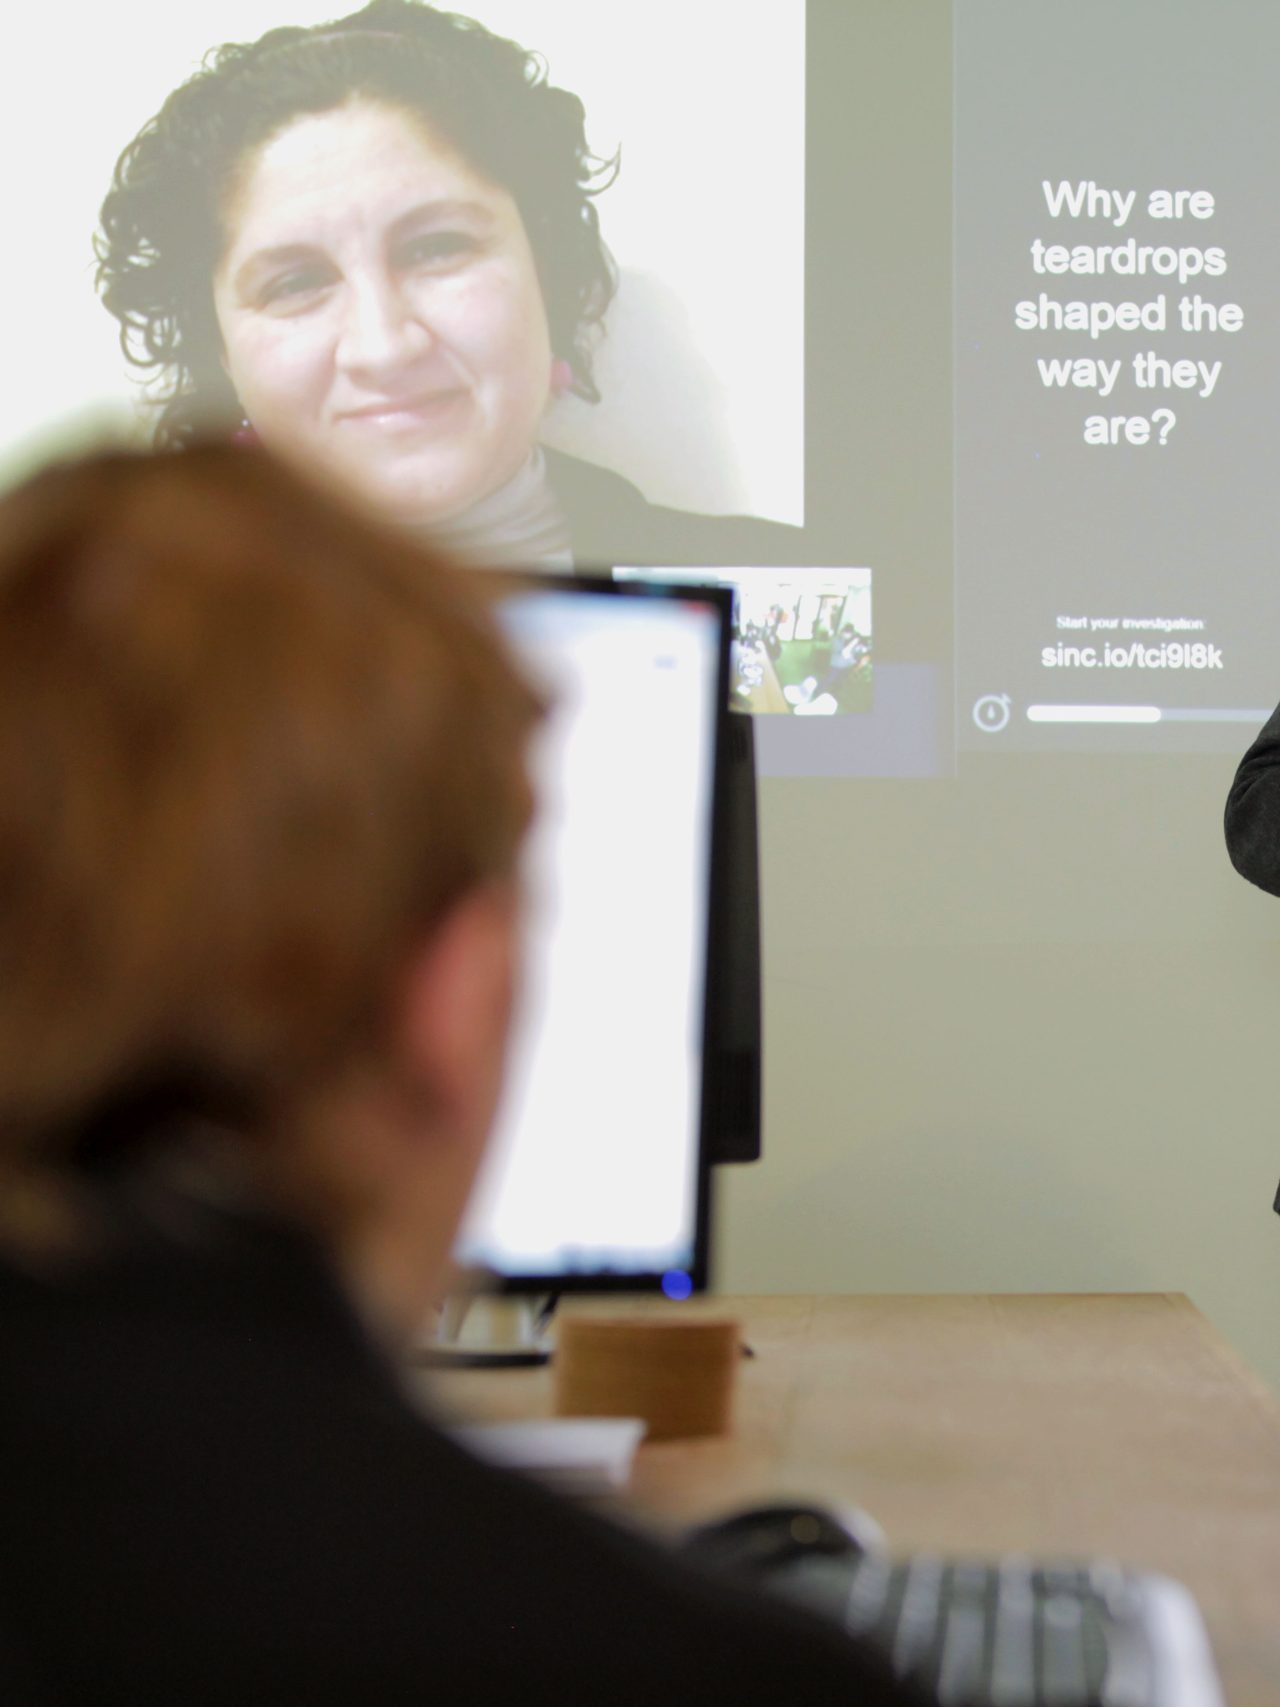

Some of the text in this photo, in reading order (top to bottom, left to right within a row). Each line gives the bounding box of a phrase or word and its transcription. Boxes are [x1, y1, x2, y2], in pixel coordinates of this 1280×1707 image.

[1042, 180, 1215, 227] Why are
[1030, 238, 1227, 284] teardrops
[1014, 293, 1244, 339] shaped the
[1037, 351, 1222, 398] way they
[1083, 408, 1176, 446] are?
[1090, 618, 1119, 631] your
